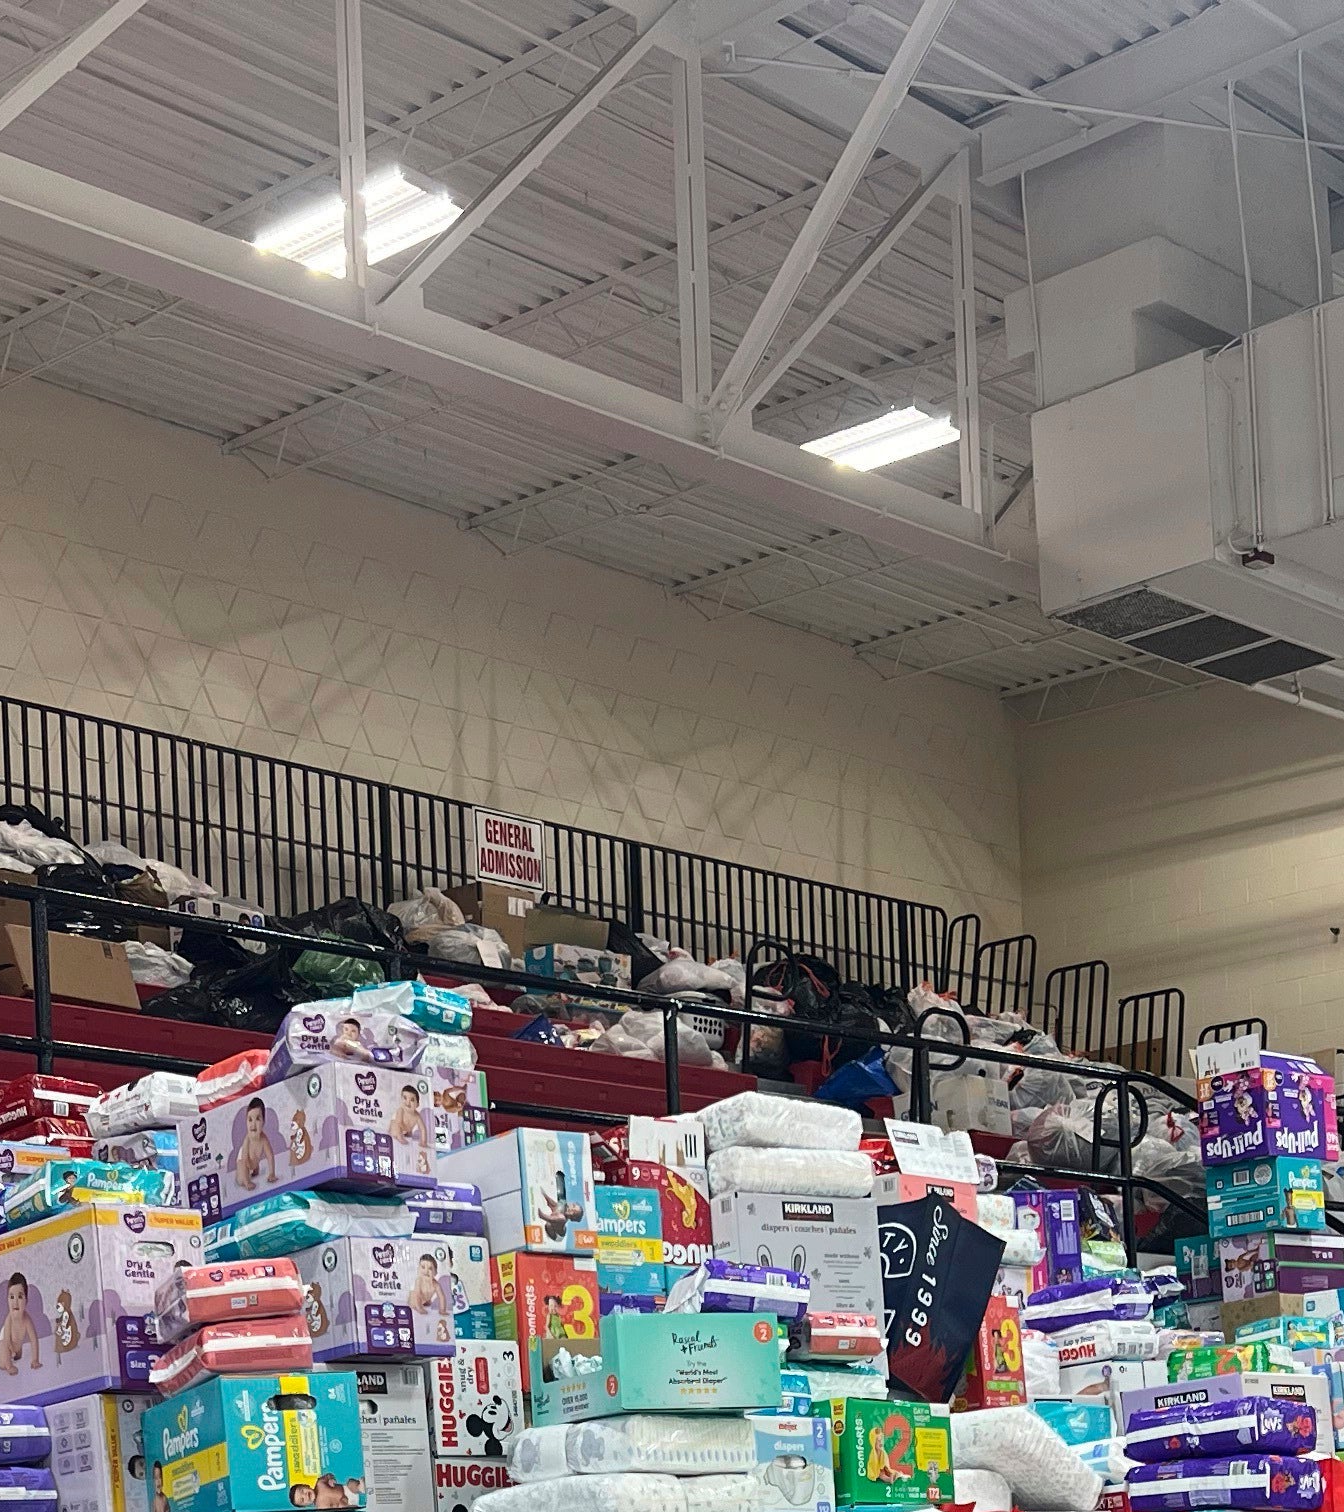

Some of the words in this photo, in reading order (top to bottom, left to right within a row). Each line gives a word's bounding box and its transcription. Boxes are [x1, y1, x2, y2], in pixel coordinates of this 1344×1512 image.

[485, 819, 536, 852] GENERAL
[480, 847, 542, 883] ADMISSION
[354, 1096, 371, 1108] Dry
[374, 1098, 379, 1107] &
[353, 1107, 383, 1118] Gentle
[784, 1204, 832, 1216] KIRKLAND
[761, 1223, 790, 1233] diapers
[794, 1225, 824, 1234] couches
[830, 1225, 856, 1235] pañales
[926, 1205, 950, 1266] Since
[906, 1273, 937, 1348] 1999
[672, 1331, 700, 1345] Rascal
[503, 1351, 514, 1361] 3
[1157, 1391, 1206, 1407] KIRKLAND
[383, 1415, 417, 1425] pañales
[163, 1426, 199, 1459] Pampers
[258, 1401, 284, 1492] Pampers
[774, 1441, 805, 1452] diapers
